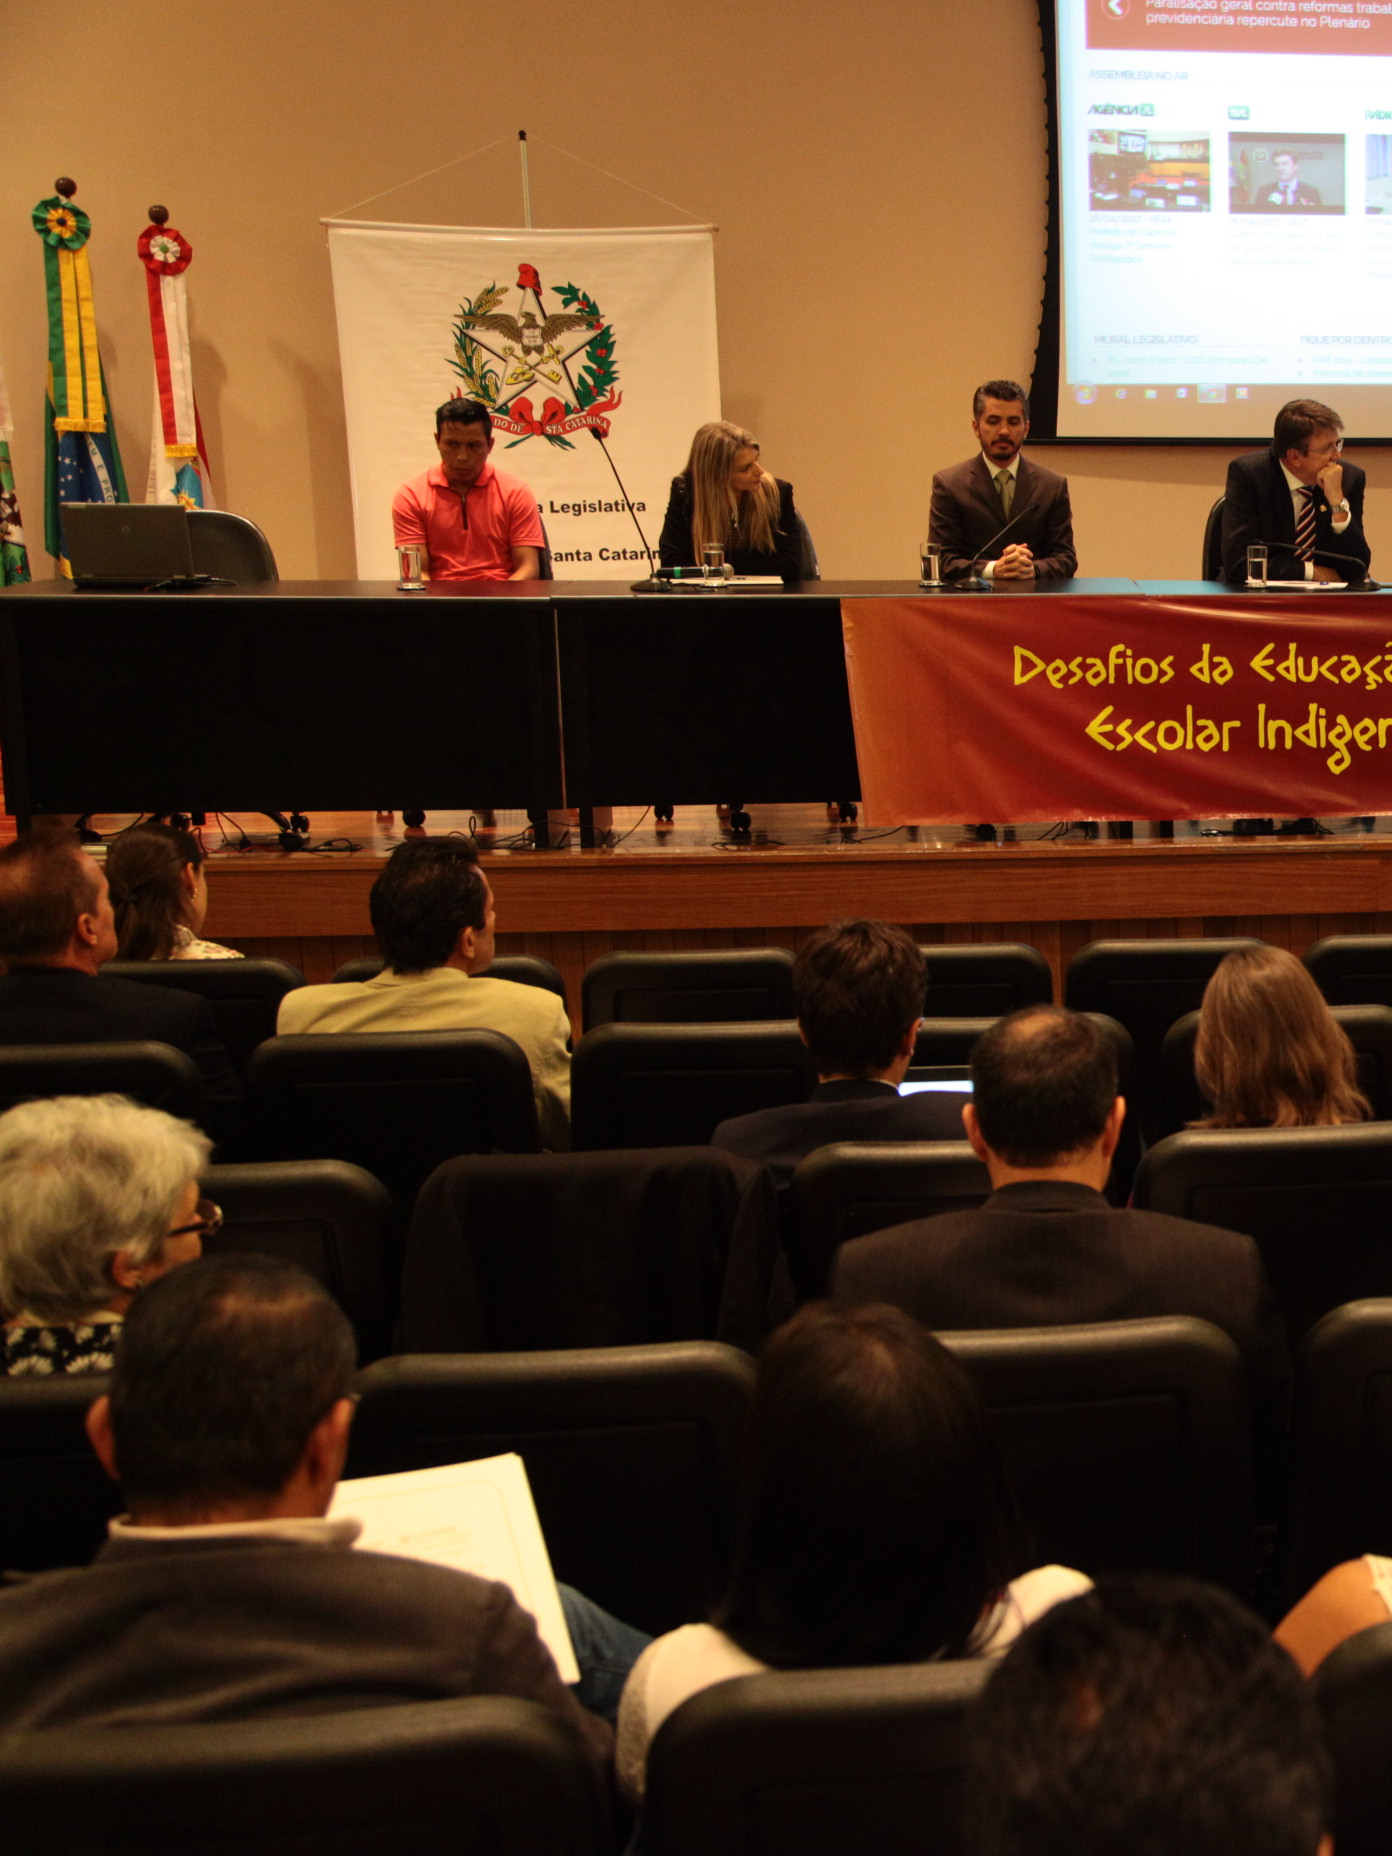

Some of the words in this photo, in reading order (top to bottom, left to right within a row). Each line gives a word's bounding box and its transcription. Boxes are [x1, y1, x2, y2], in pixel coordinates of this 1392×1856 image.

[1220, 0, 1252, 12] geral
[1256, 0, 1295, 11] contra
[1299, 1, 1353, 12] reformas
[1146, 12, 1233, 27] previdenciária
[1237, 16, 1297, 28] repercute
[1301, 18, 1316, 27] no
[1320, 16, 1371, 29] Plenário
[1089, 70, 1153, 80] ASSEMBLEIA
[1156, 71, 1172, 80] NO
[1175, 72, 1188, 80] AR
[1088, 103, 1140, 115] AGÊNCIA
[1093, 334, 1131, 344] MURAL
[1133, 334, 1197, 344] LEGISLATIVO
[1300, 335, 1330, 345] FIQUE
[1331, 335, 1352, 345] POR
[510, 424, 525, 433] DE
[545, 425, 563, 434] STA
[565, 416, 608, 429] CATARINA
[550, 499, 646, 517] Legislativa
[1013, 643, 1175, 689] Desafios
[1189, 643, 1234, 685] da
[1085, 705, 1241, 753] Escolar
